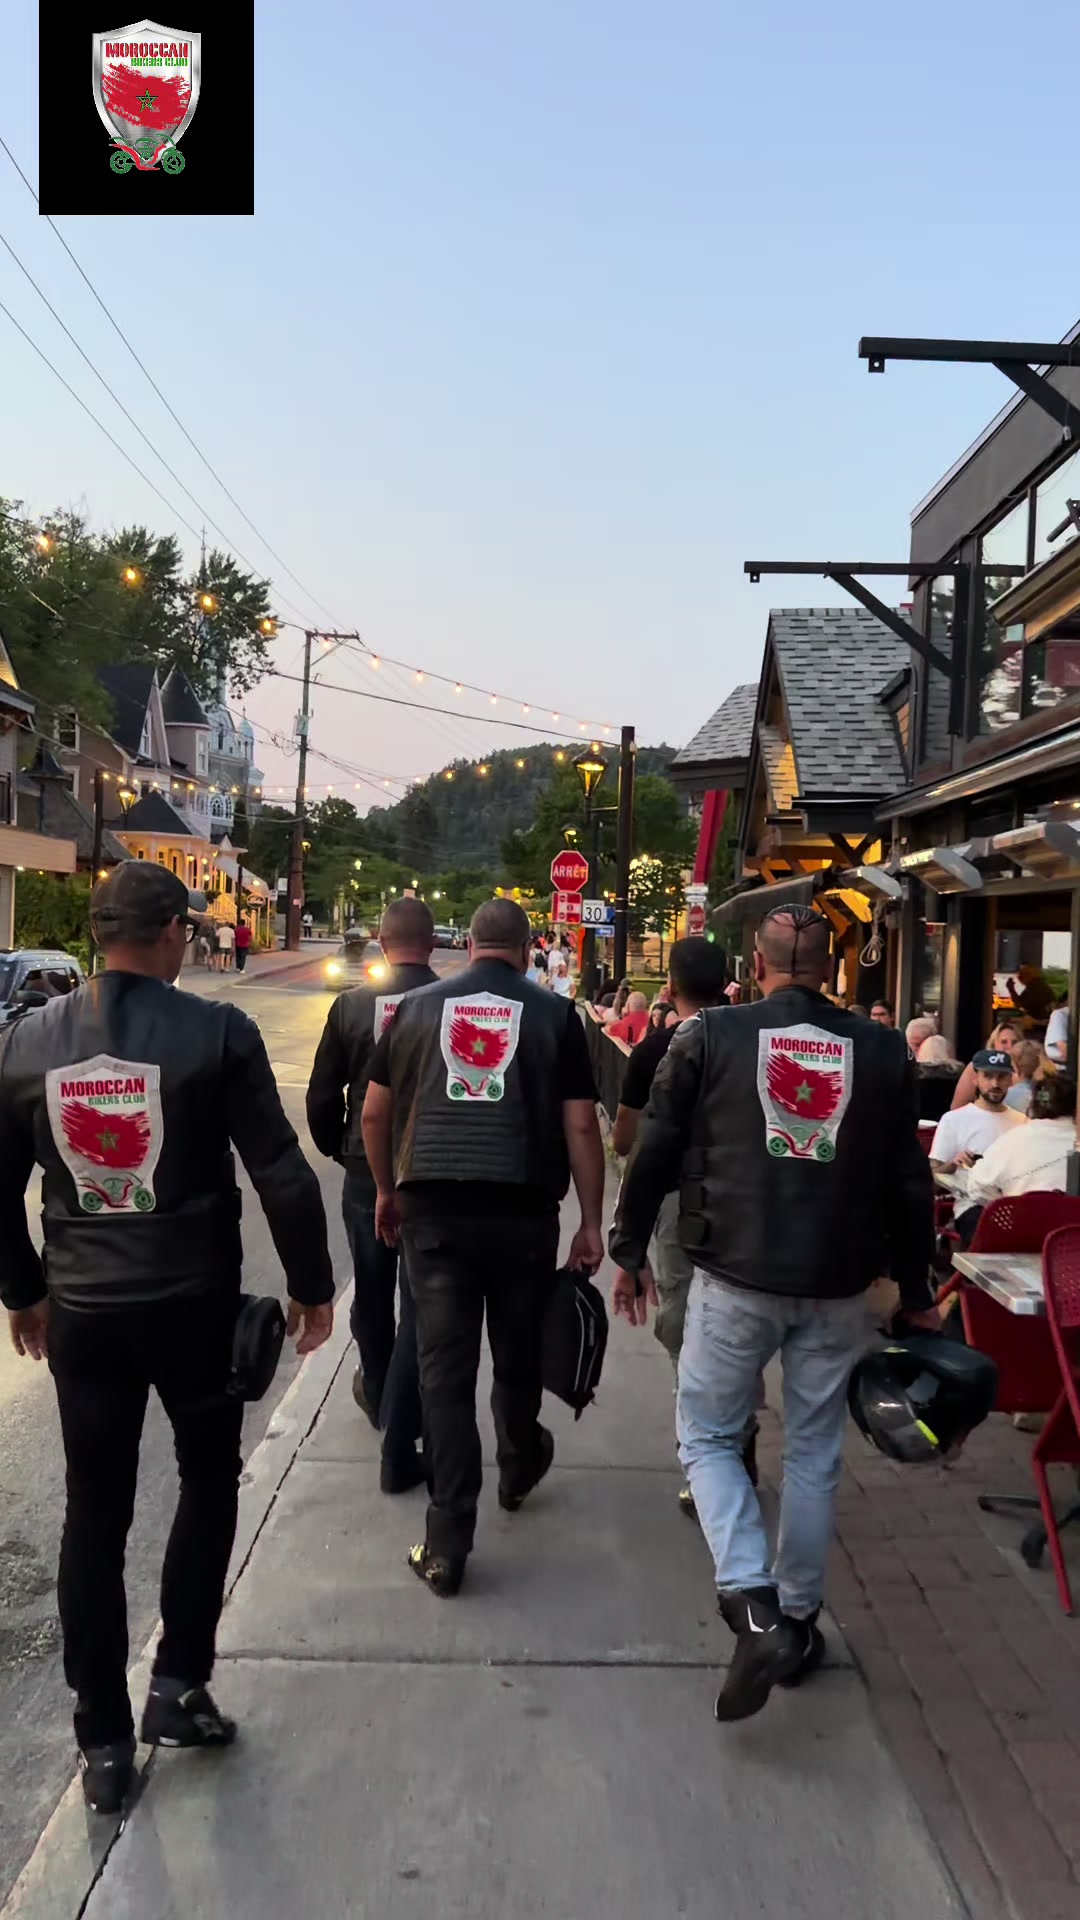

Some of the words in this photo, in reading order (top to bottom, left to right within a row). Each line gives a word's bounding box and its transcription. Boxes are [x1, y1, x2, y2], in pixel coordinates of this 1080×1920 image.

[553, 863, 588, 878] ARRÊT
[585, 907, 602, 921] 30
[454, 1005, 512, 1017] MOROCCAN
[771, 1037, 843, 1056] MOROCCAN
[822, 1055, 842, 1064] CLUB
[61, 1077, 145, 1097] MOROCCAN
[122, 1094, 146, 1104] CLUB
